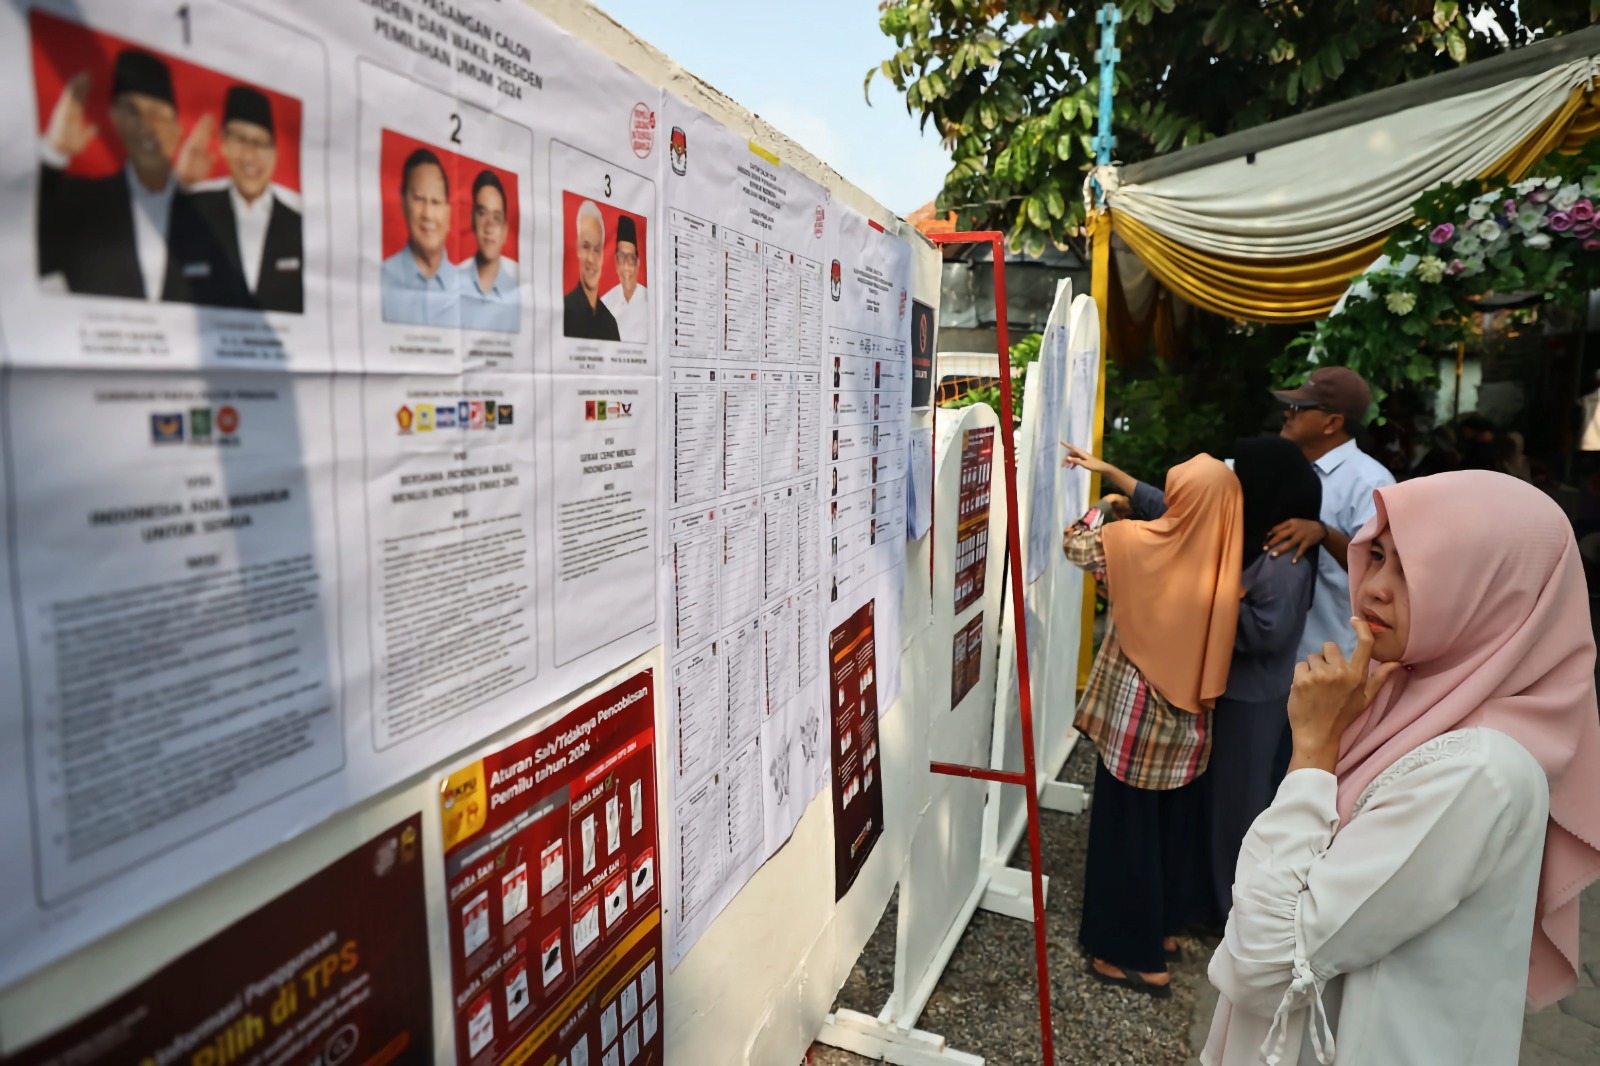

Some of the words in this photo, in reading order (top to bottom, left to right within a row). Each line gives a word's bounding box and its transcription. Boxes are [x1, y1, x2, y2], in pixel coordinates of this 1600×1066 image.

[176, 5, 191, 46] 1
[374, 17, 451, 67] PEMILIHAN
[497, 75, 522, 100] 2024
[417, 13, 448, 42] DAN
[451, 31, 490, 65] WAKIL
[493, 52, 543, 90] PRESIDEN
[495, 31, 532, 63] CALON
[449, 112, 463, 145] 2
[603, 174, 612, 199] 3
[489, 755, 533, 789] Aturan
[535, 716, 597, 764] Sah/Tidaknya
[597, 686, 648, 724] Pencoblosan
[490, 776, 534, 809] Pemilu
[535, 756, 567, 782] tahun
[567, 739, 591, 765] 2024
[269, 981, 298, 1026] di
[304, 940, 358, 998] TPS
